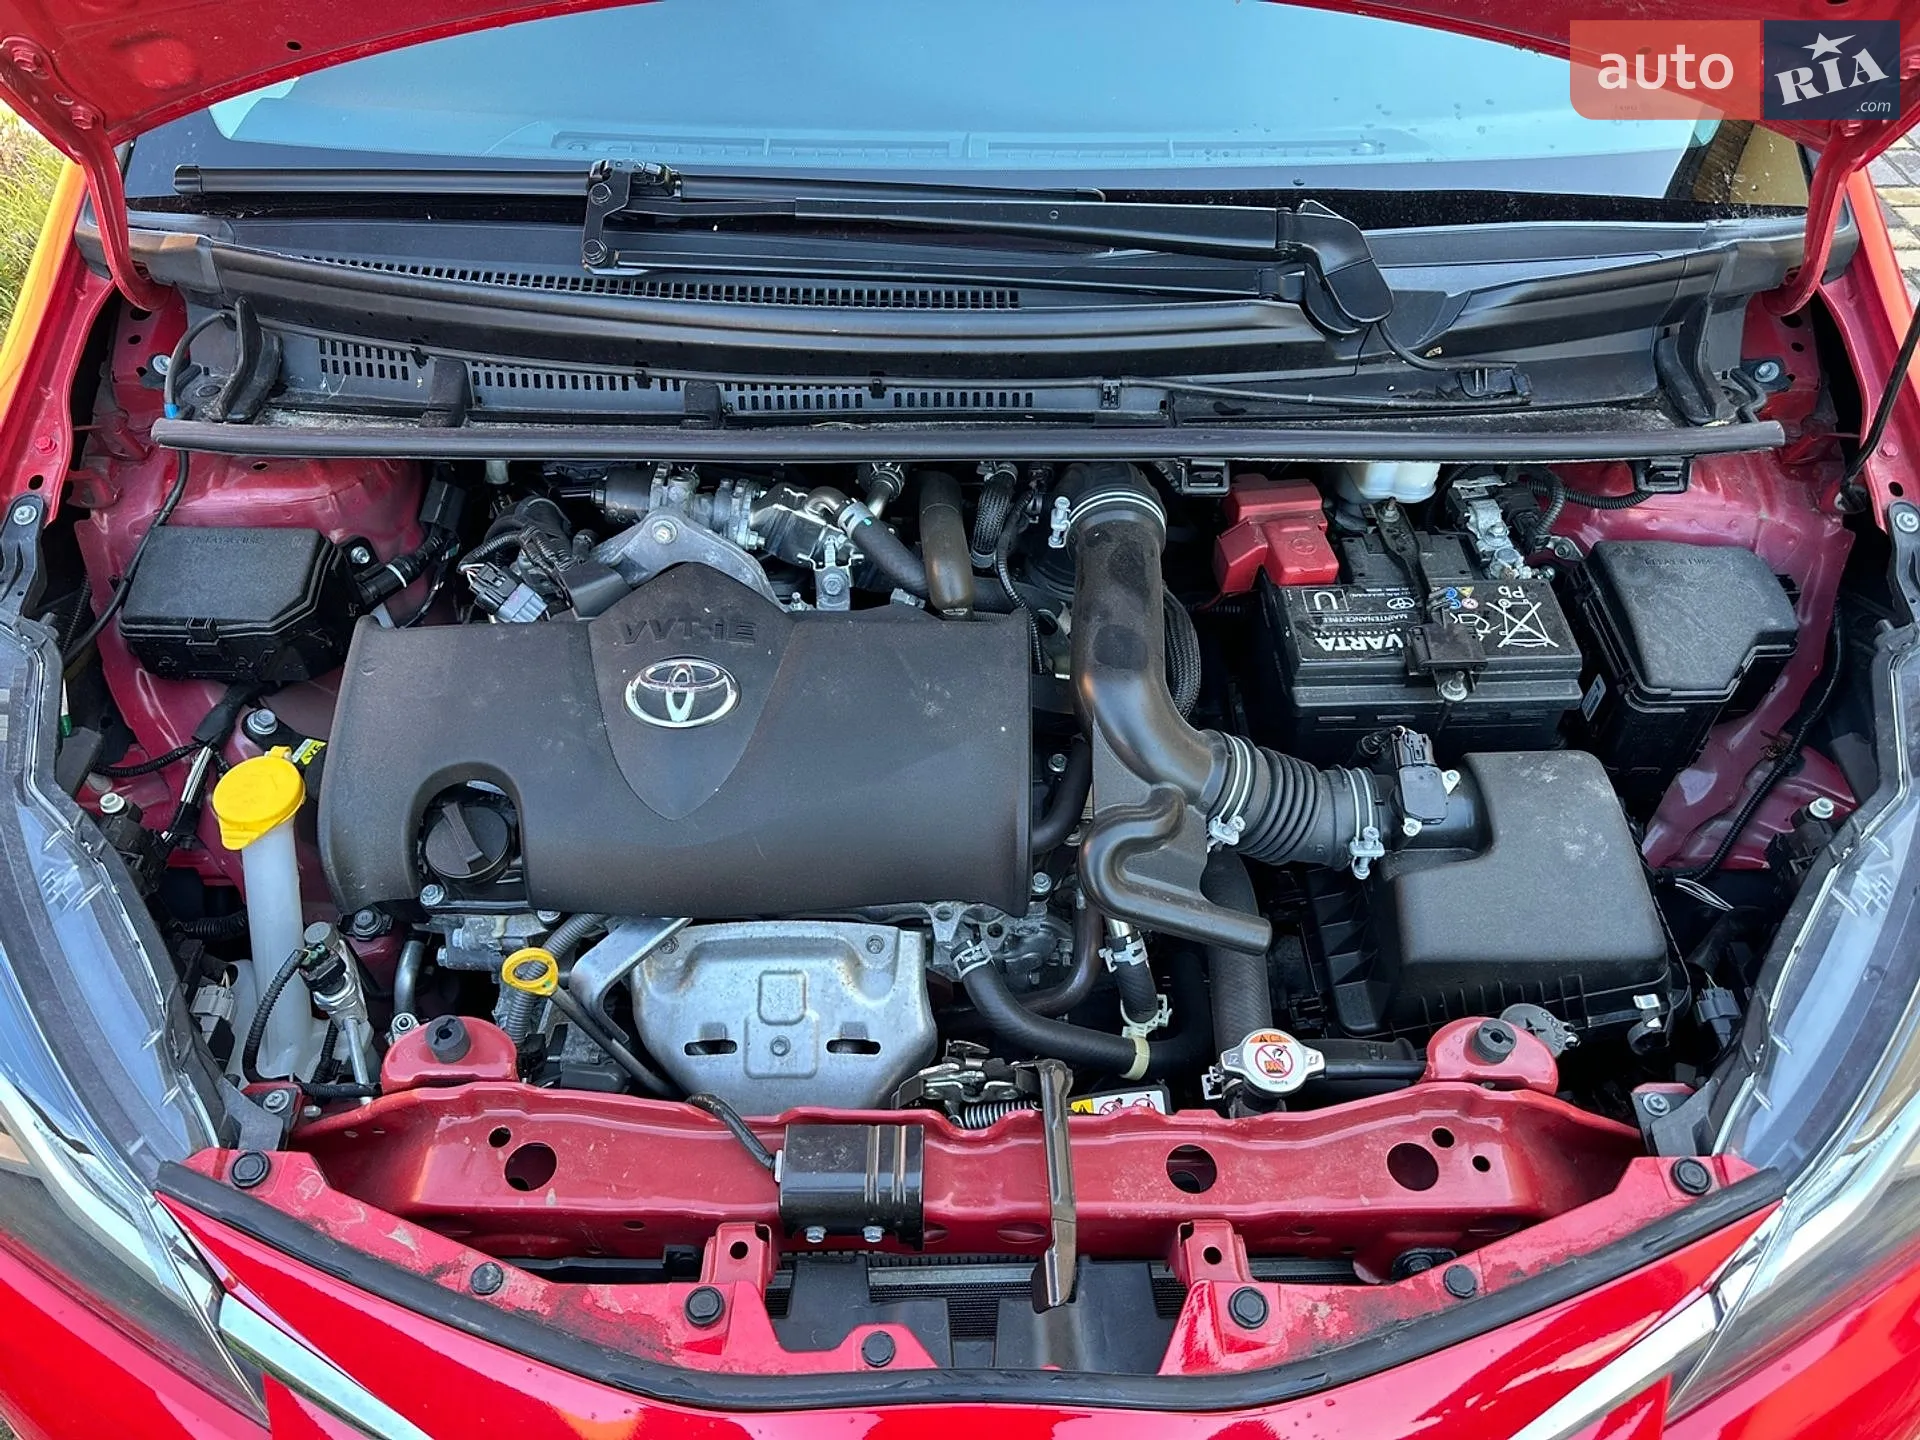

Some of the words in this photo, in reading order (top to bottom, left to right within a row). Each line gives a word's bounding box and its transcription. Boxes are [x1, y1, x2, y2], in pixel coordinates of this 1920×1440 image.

[1498, 585, 1524, 598] Pb
[1313, 592, 1338, 610] U
[1315, 634, 1404, 651] VARTA
